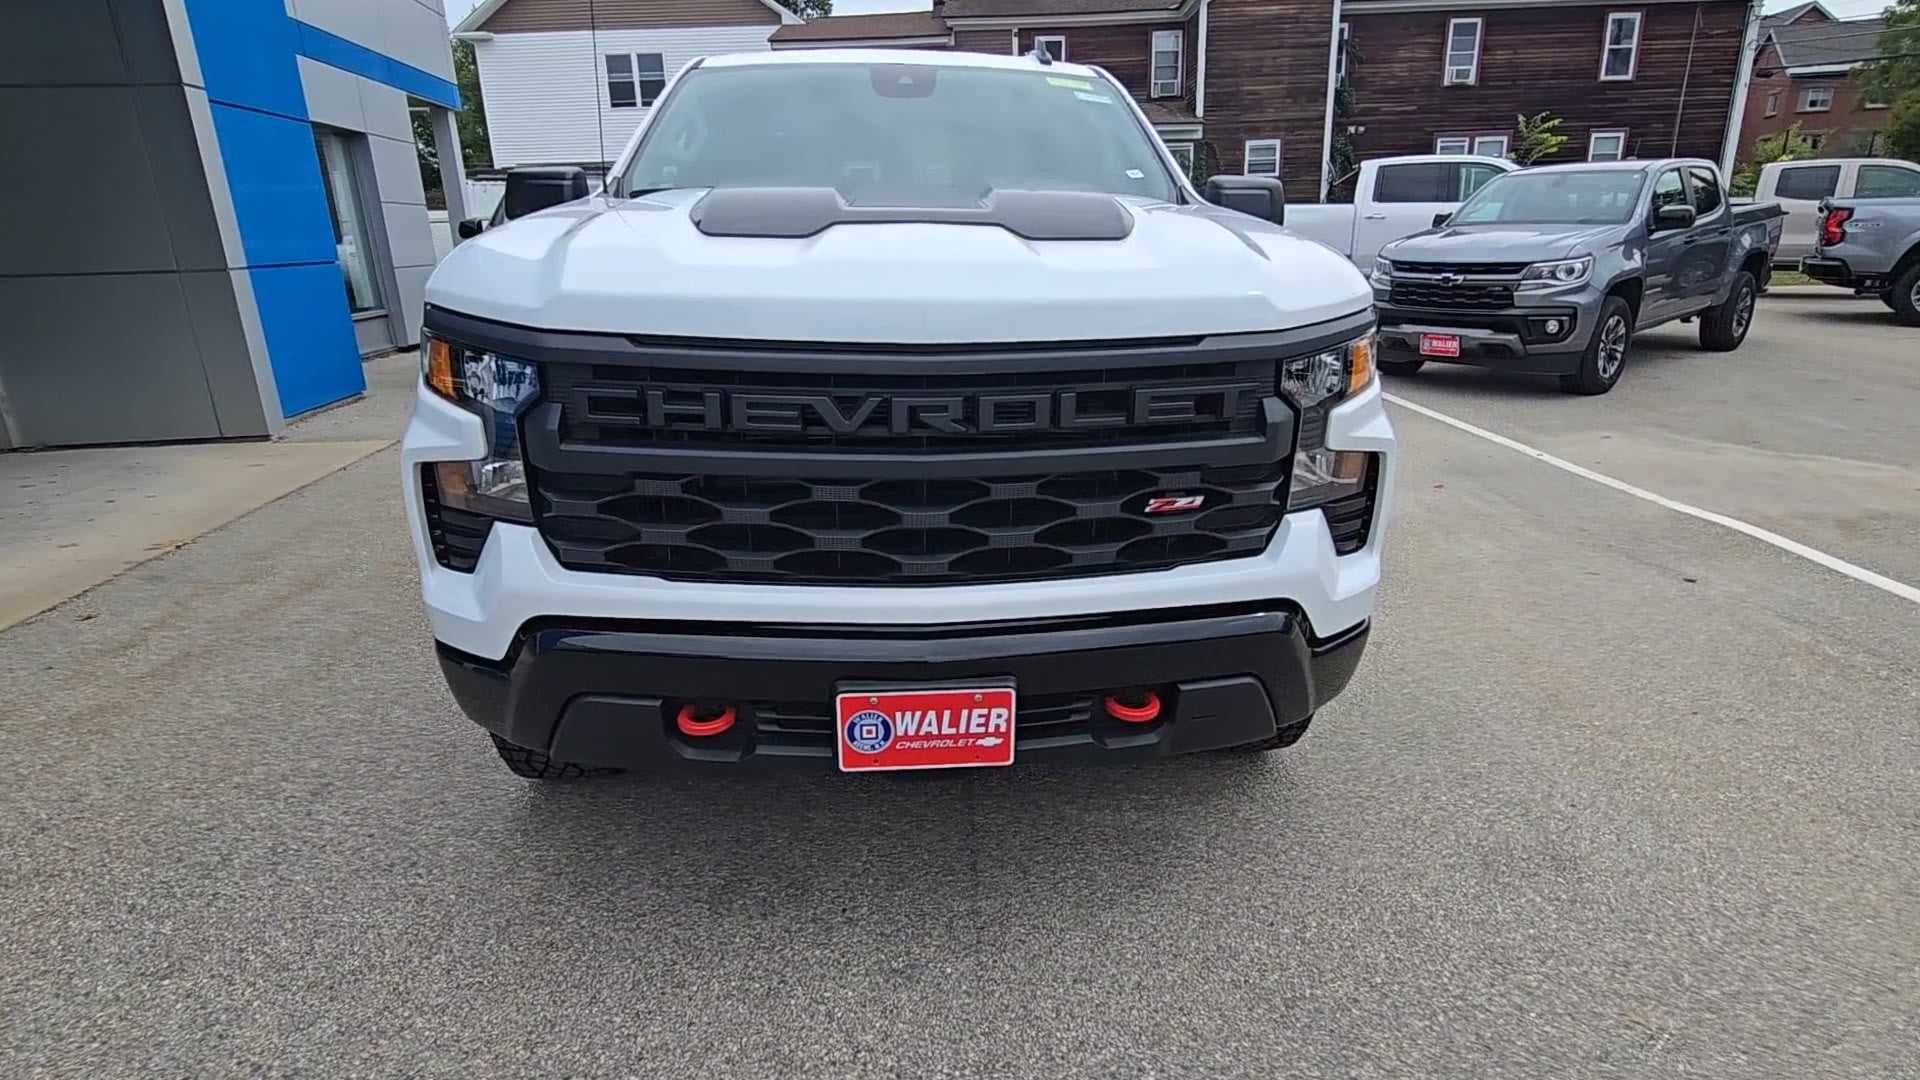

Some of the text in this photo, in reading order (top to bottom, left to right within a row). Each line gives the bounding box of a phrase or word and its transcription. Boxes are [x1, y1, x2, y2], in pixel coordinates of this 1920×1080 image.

[572, 382, 1260, 433] CHEVROLET
[1144, 496, 1205, 513] Z71
[894, 708, 1008, 736] WALIER
[896, 738, 976, 749] CHEVROLET
